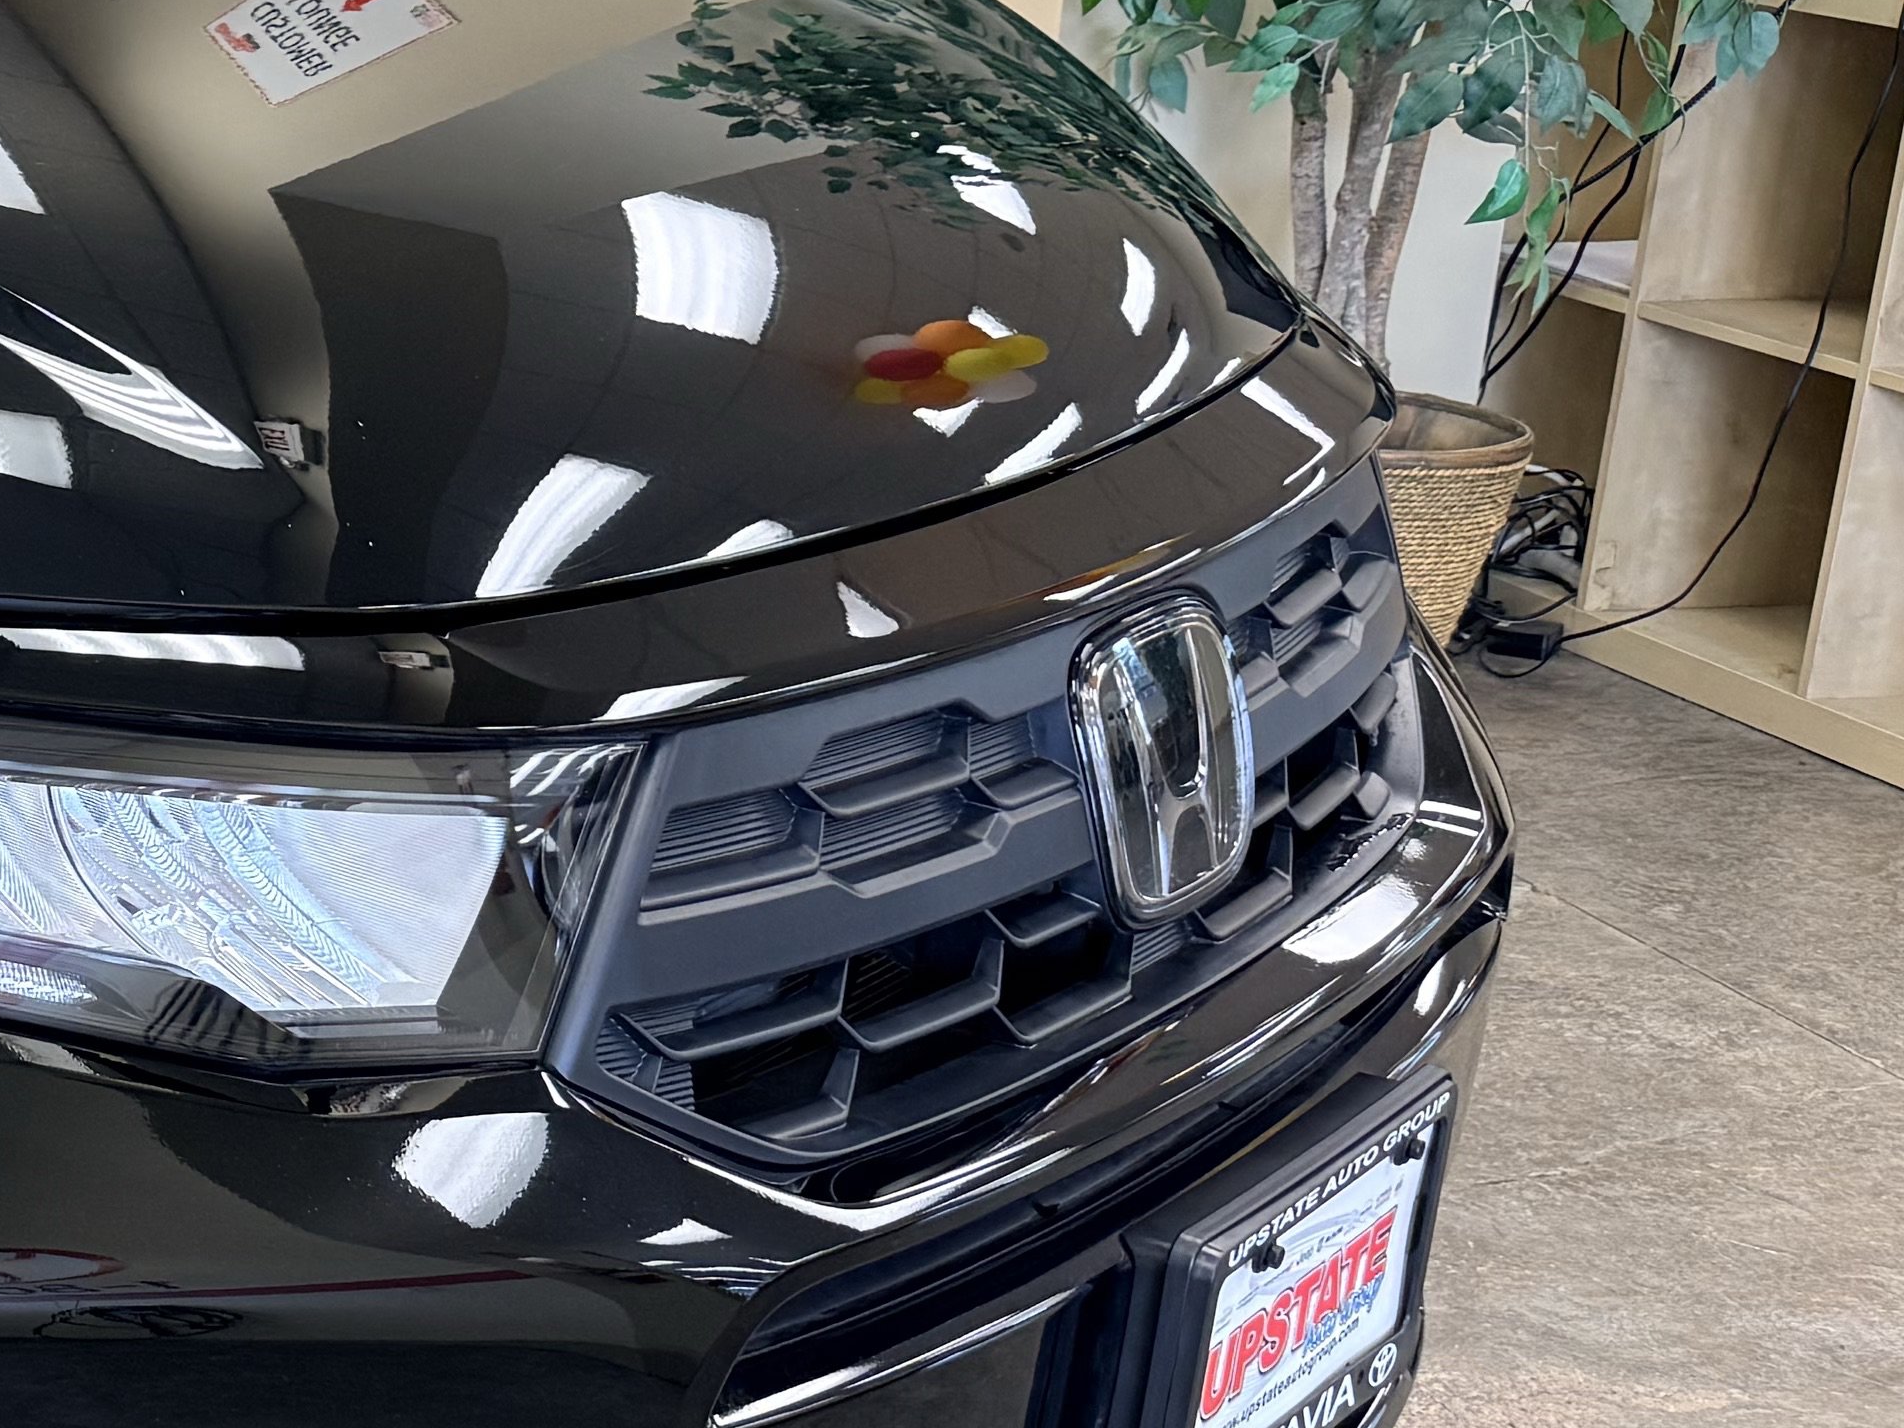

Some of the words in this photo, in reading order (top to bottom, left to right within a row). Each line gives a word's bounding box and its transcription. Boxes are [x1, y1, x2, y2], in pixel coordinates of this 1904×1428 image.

[1227, 1186, 1321, 1268] UPSTATE
[1321, 1145, 1380, 1199] AUTO
[1383, 1091, 1451, 1152] GROUP
[1200, 1205, 1399, 1421] UPSTATE
